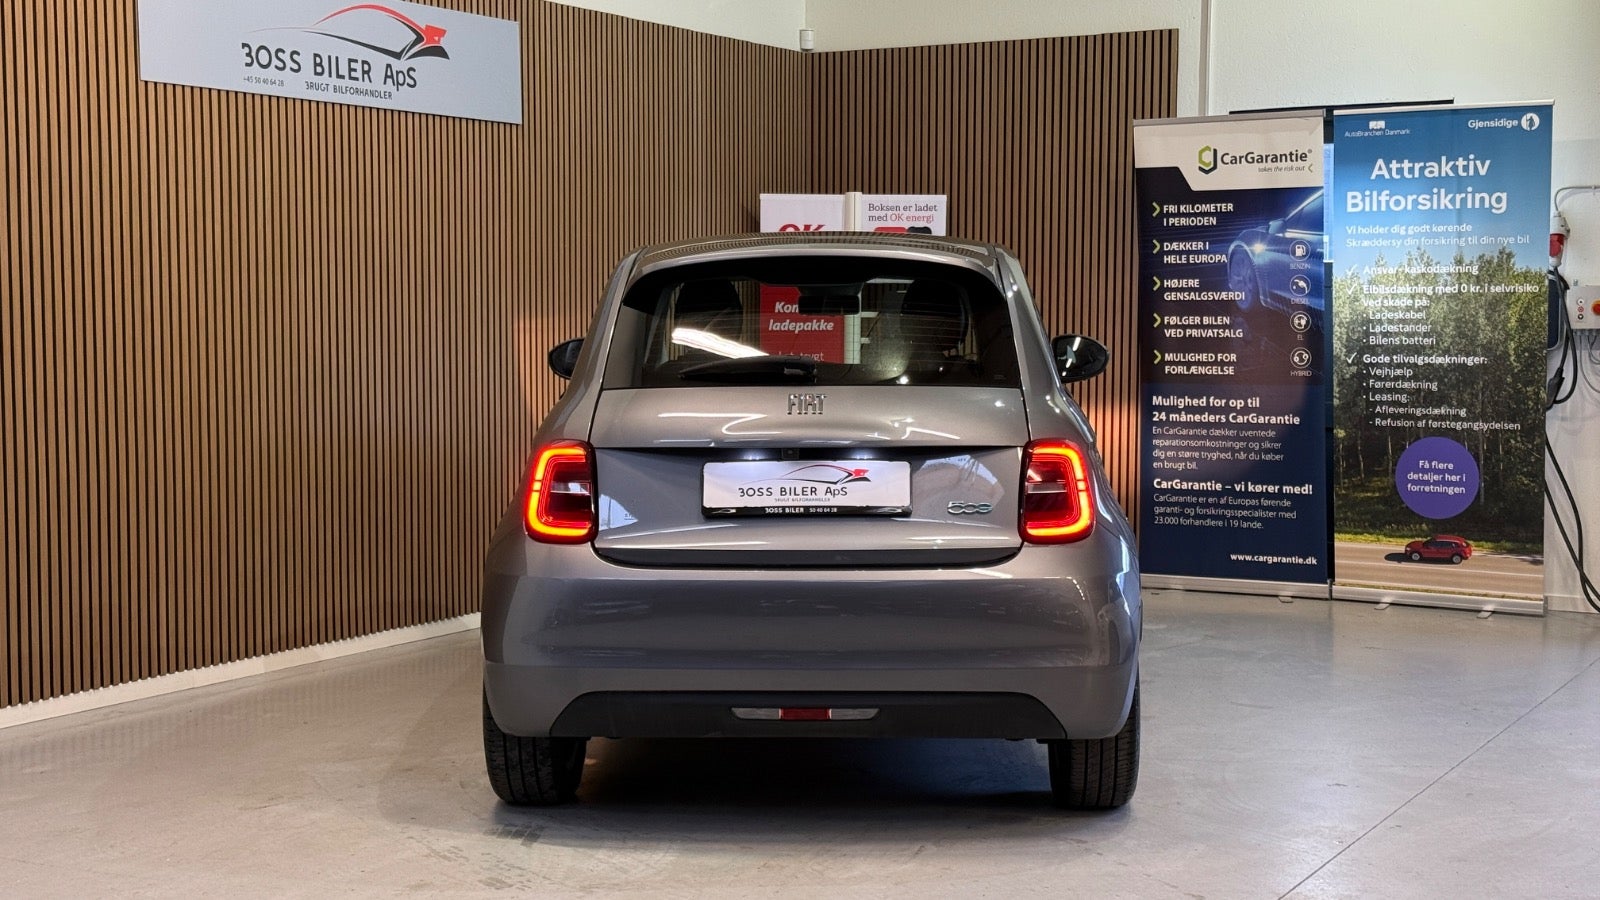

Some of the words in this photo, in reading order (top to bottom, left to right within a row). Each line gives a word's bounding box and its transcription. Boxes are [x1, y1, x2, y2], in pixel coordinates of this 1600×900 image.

[313, 53, 372, 83] BILER
[383, 63, 417, 92] ApS
[254, 76, 262, 84] 50
[262, 77, 269, 85] 40
[269, 78, 277, 86] 64
[277, 79, 284, 87] 28
[333, 84, 393, 100] BILFORHANDLER
[1468, 119, 1518, 129] Gjensidige
[1385, 128, 1410, 136] Danmark
[1274, 165, 1283, 173] the
[1370, 154, 1491, 180] Attraktiv
[1346, 187, 1508, 214] Bilforsikring
[868, 204, 901, 212] Boksen
[914, 204, 938, 212] ladet
[1163, 205, 1178, 214] FRI
[1179, 203, 1234, 213] KILOMETER
[905, 214, 934, 223] energi
[1169, 216, 1217, 226] PERIODEN
[1346, 226, 1357, 234] Vi
[1358, 225, 1389, 234] holder
[1391, 224, 1406, 235] dig
[1407, 224, 1430, 235] godt
[1432, 223, 1473, 232] kørende
[1163, 242, 1204, 251] DÆKKER
[1345, 238, 1402, 248] Skræddersy
[1404, 237, 1419, 246] din
[1421, 236, 1466, 246] forsikring
[1468, 235, 1478, 245] til
[1480, 236, 1495, 244] din
[1497, 236, 1514, 246] nye
[1517, 235, 1529, 244] bil
[1164, 254, 1188, 263] HELE
[1189, 254, 1228, 264] EUROPA
[1404, 264, 1479, 274] kaskodækning
[1164, 279, 1200, 288] HØJERE
[1363, 284, 1433, 295] Elbilsdækning
[1435, 284, 1458, 293] med
[1470, 284, 1483, 293] kr.
[1490, 284, 1539, 293] selvrisiko
[1164, 292, 1245, 301] GENSALGSVÆRDI
[1383, 297, 1414, 306] skade
[1415, 298, 1430, 308] på:
[1164, 316, 1200, 325] FØLGER
[1203, 316, 1230, 324] BILEN
[1369, 311, 1426, 320] Ladeskabel
[769, 319, 834, 334] ladepakke
[1369, 324, 1432, 332] Ladestander
[1164, 329, 1185, 338] VED
[1186, 329, 1243, 338] PRIVATSALG
[1369, 336, 1400, 345] Bilens
[1402, 336, 1435, 345] batteri
[1165, 353, 1216, 362] MULIGHED
[1218, 353, 1237, 362] FOR
[1363, 355, 1391, 363] Gode
[1393, 354, 1488, 366] tilvalgsdækninger:
[1165, 366, 1235, 375] FORLÆNGELSE
[1369, 368, 1413, 378] Vejhjælp
[1369, 380, 1438, 391] Førerdækning
[787, 393, 828, 415] FIAT
[1152, 395, 1206, 408] Mulighed
[1209, 397, 1225, 407] for
[1229, 398, 1245, 409] op
[1247, 397, 1259, 408] til
[1375, 406, 1467, 417] Afleveringsdækning
[1152, 412, 1167, 421] 24
[1169, 412, 1226, 423] måneders
[1229, 413, 1300, 424] CarGarantie
[1375, 419, 1415, 427] Refusion
[1416, 419, 1426, 428] af
[1428, 420, 1521, 432] førstegangsydelsen
[1163, 427, 1207, 436] CarGarantie
[1239, 429, 1276, 437] uventede
[1152, 439, 1247, 449] reparationsomkostninger
[1248, 441, 1259, 450] og
[1261, 441, 1281, 449] sikrer
[1152, 450, 1165, 458] dig
[1201, 452, 1233, 461] tryghed,
[1261, 453, 1284, 461] køber
[1164, 461, 1185, 470] brugt
[1187, 461, 1198, 470] bil.
[1419, 460, 1430, 469] Få
[1431, 460, 1454, 470] flere
[1407, 472, 1443, 482] detaljer
[1445, 474, 1460, 482] her
[780, 486, 818, 497] BILER
[824, 486, 848, 498] ApS
[1153, 479, 1222, 491] CarGarantie
[1234, 482, 1245, 491] vi
[1248, 482, 1279, 493] kører
[1283, 484, 1313, 495] med!
[1407, 483, 1466, 495] forretningen
[1153, 494, 1198, 503] CarGarantie
[1220, 496, 1227, 504] af
[1228, 497, 1259, 506] Europas
[1261, 499, 1291, 507] førende
[1154, 506, 1182, 515] garanti-
[1184, 507, 1195, 516] og
[1196, 507, 1277, 518] forsikringsspecialister
[1278, 511, 1297, 519] med
[1154, 517, 1179, 525] 23.000
[1180, 518, 1223, 526] forhandlere
[1240, 520, 1264, 529] lande.
[1230, 553, 1317, 565] www.cargarantie.dk
